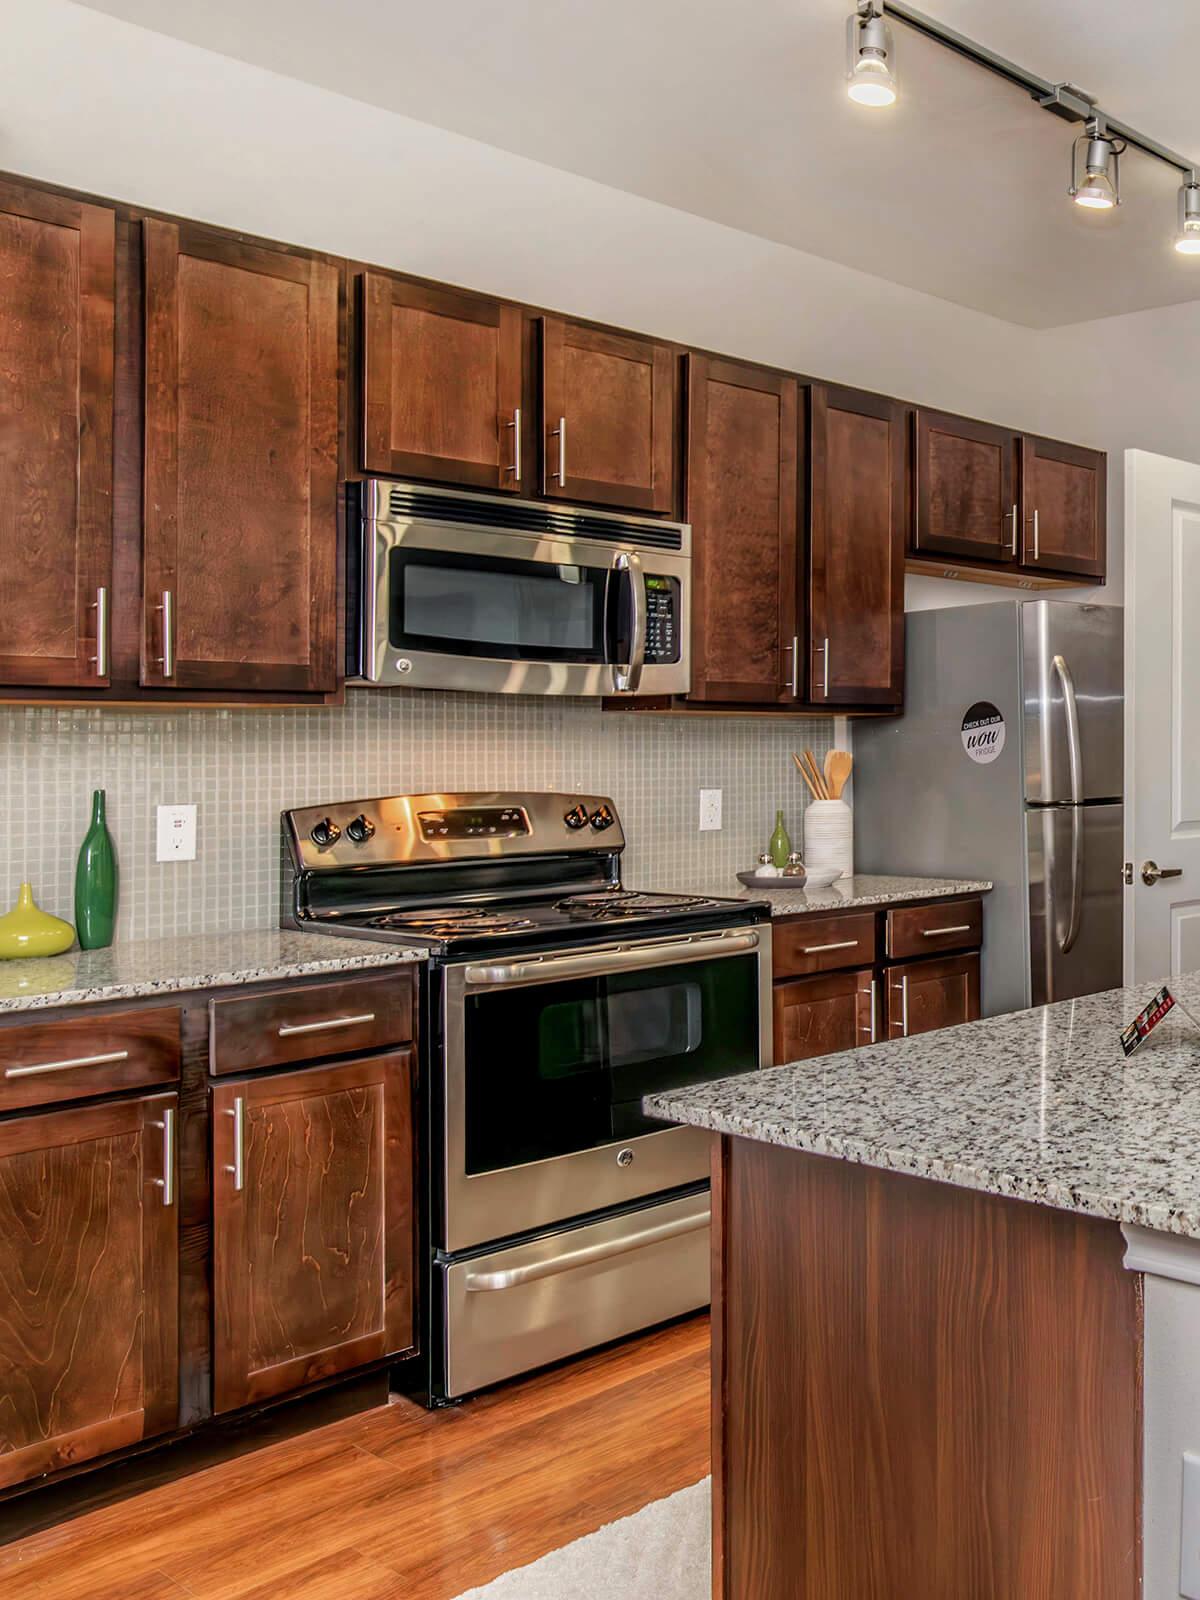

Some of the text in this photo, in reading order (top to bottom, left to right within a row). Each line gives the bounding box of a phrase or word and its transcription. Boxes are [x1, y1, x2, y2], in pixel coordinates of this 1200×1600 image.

[963, 715, 1001, 730] CHECK OUT OUR
[975, 746, 996, 757] FRIDGE
